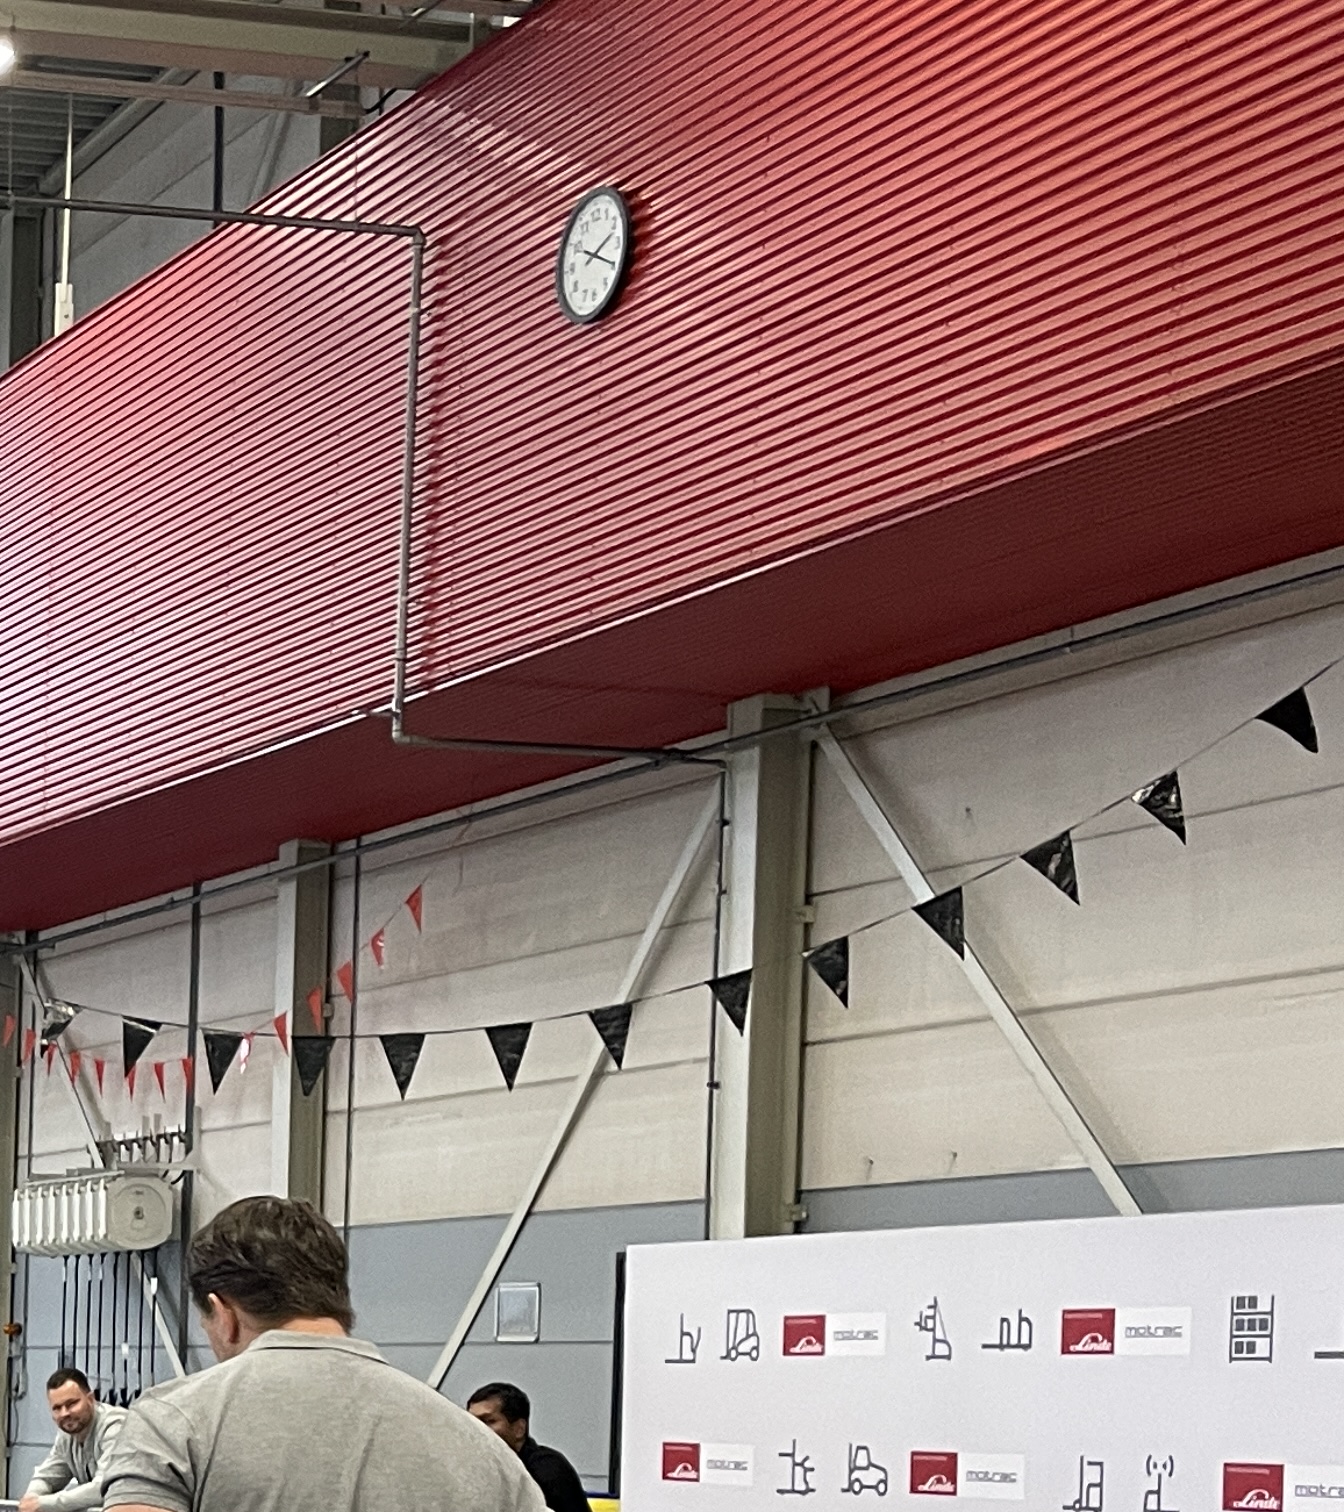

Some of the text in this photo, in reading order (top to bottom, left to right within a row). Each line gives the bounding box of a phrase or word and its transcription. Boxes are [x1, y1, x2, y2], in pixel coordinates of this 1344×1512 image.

[1125, 1325, 1184, 1338] motrac
[966, 1470, 1017, 1483] motrac
[1233, 1489, 1280, 1509] Linde
